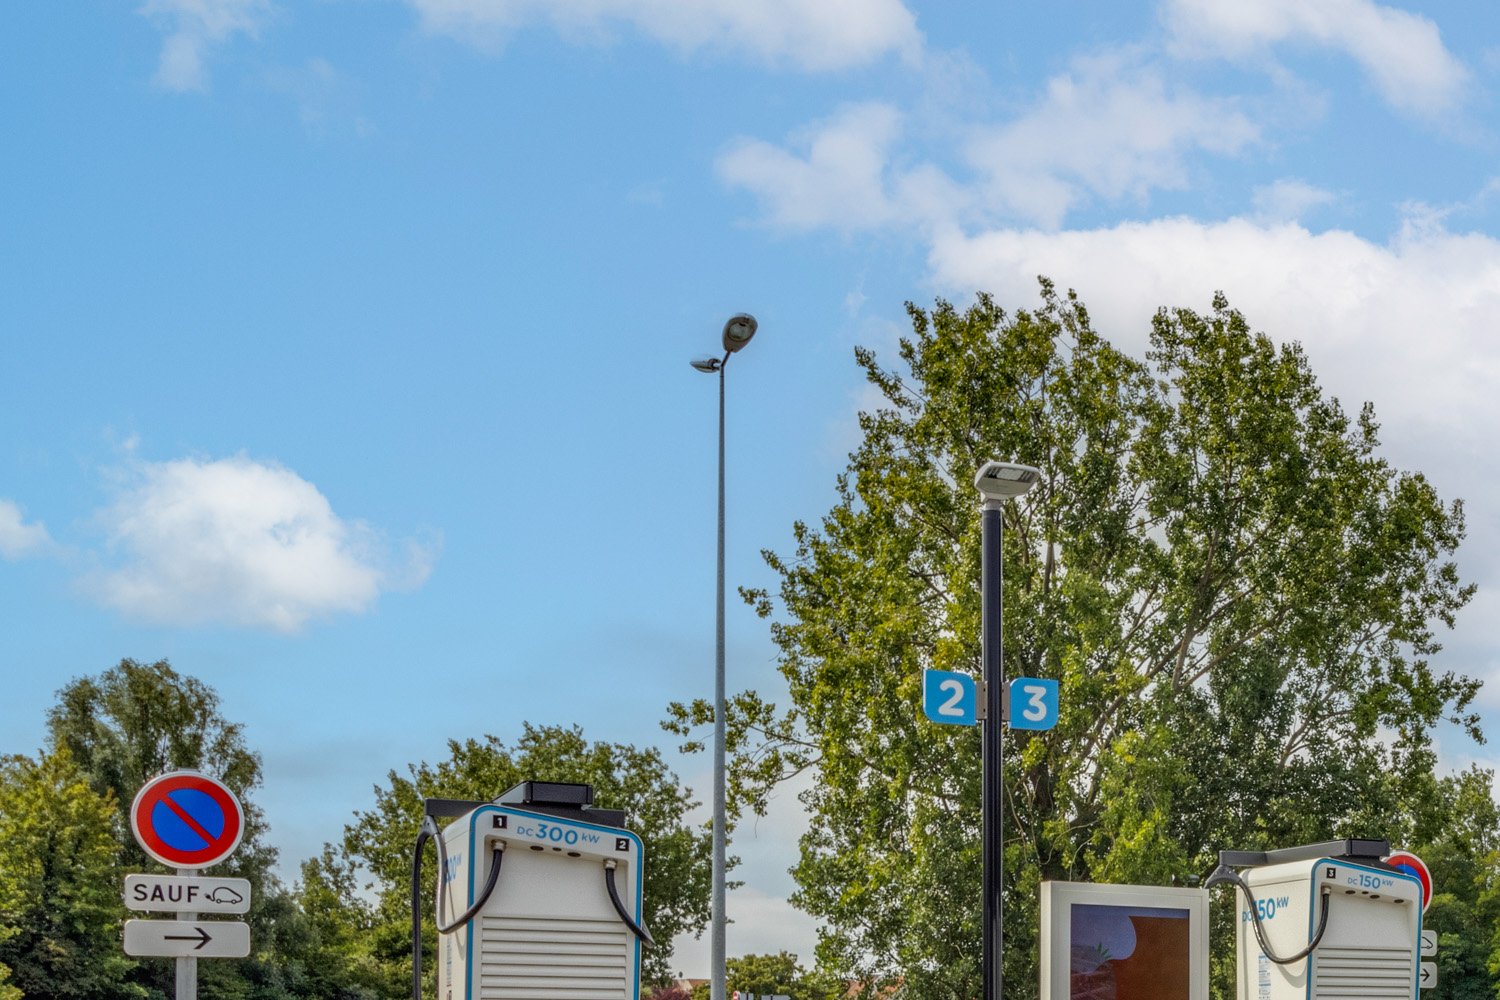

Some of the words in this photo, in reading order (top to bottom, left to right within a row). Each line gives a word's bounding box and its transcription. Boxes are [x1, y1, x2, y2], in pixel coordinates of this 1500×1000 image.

[938, 679, 965, 717] 2
[1022, 685, 1047, 722] 3
[517, 826, 534, 837] DC
[535, 823, 578, 845] 300
[581, 832, 600, 844] kW
[133, 883, 199, 903] SAUF
[1347, 877, 1358, 885] DC
[1359, 874, 1381, 889] 150
[1382, 879, 1394, 887] kW
[1253, 898, 1276, 921] 50
[1276, 896, 1289, 908] kW
